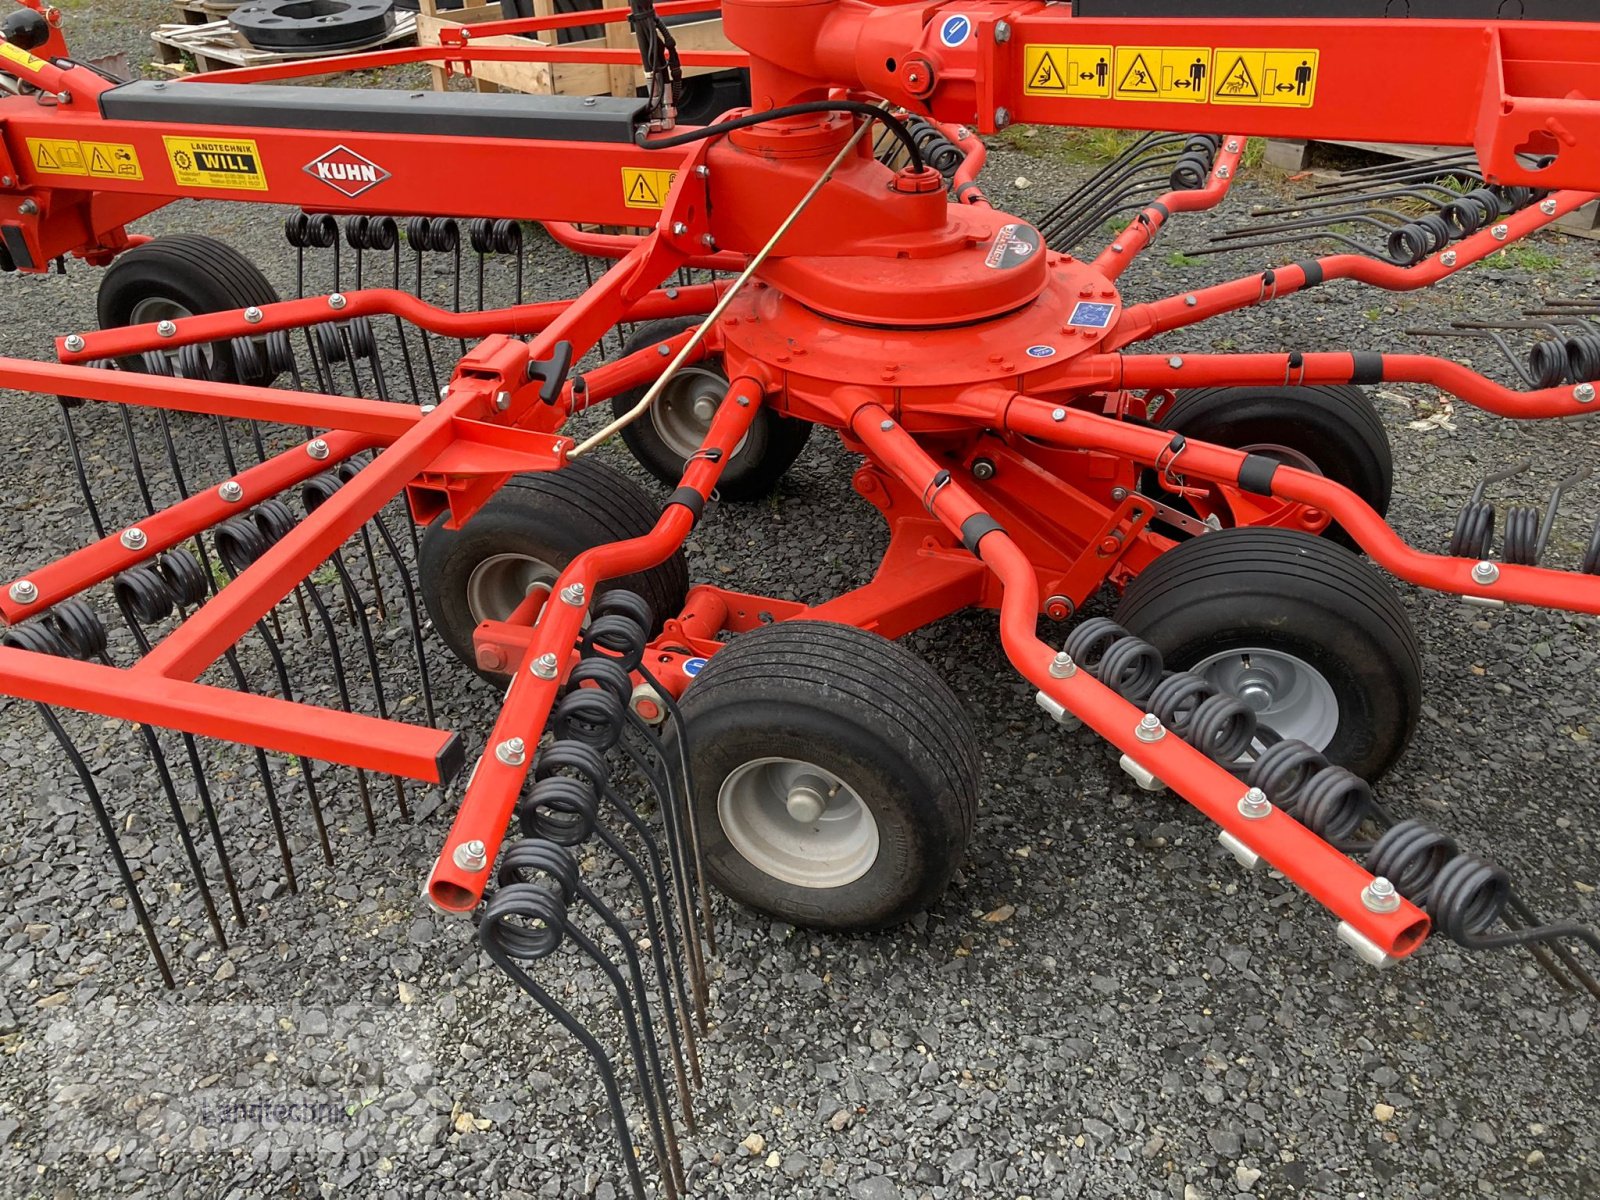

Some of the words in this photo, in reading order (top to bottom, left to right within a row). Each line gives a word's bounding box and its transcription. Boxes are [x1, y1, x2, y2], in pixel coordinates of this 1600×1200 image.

[191, 143, 252, 152] LANDTECHNIK
[201, 154, 249, 170] WILL
[317, 162, 377, 182] KUHN
